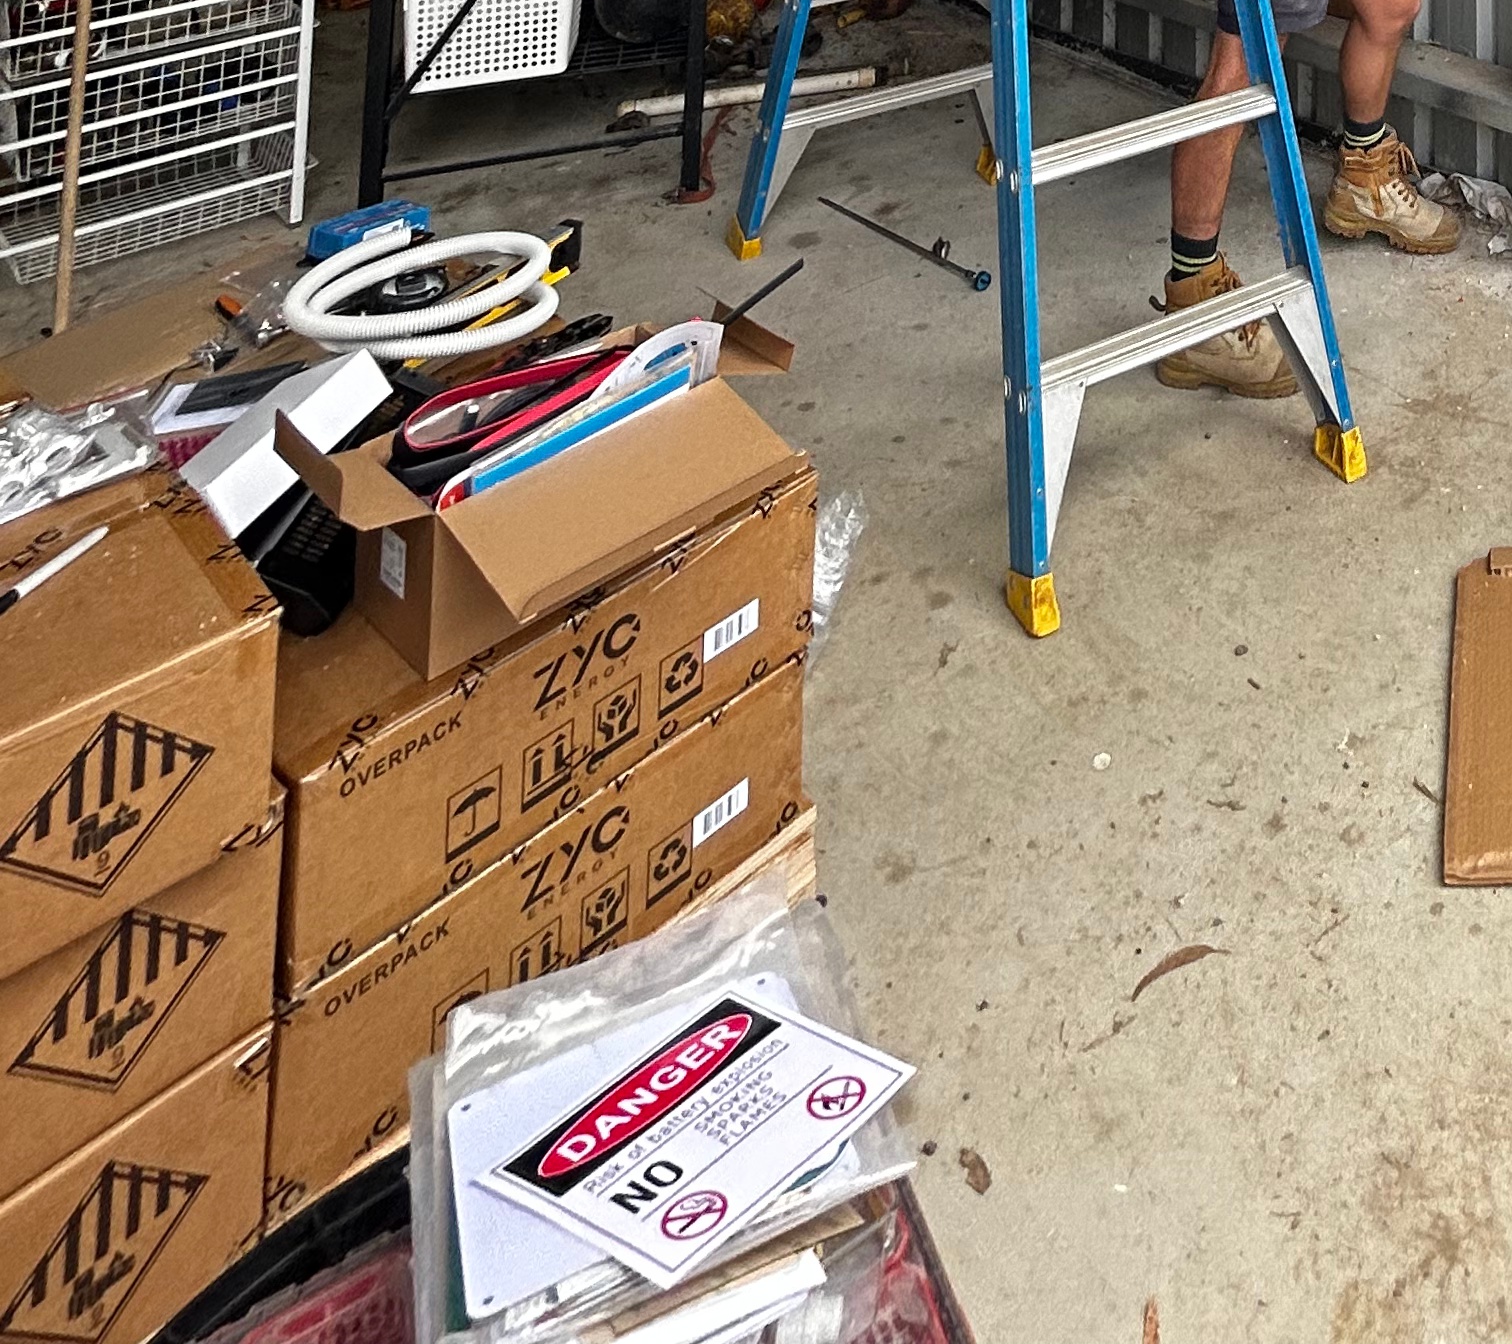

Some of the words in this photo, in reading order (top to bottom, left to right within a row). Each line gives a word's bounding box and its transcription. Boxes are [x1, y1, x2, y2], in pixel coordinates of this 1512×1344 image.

[534, 613, 640, 712] ZYC
[340, 711, 462, 798] OVERPACK
[520, 806, 630, 913] ZYC
[324, 917, 450, 1017] OVERPACK
[555, 1023, 742, 1164] DANGER
[582, 1159, 625, 1195] Risk
[627, 1140, 648, 1161] of
[647, 1093, 711, 1144] battery
[711, 1038, 783, 1102] explosion
[694, 1070, 774, 1134] SMOKING
[706, 1084, 775, 1141] SPARKS
[720, 1092, 787, 1147] FLAMES
[609, 1159, 684, 1215] NO
